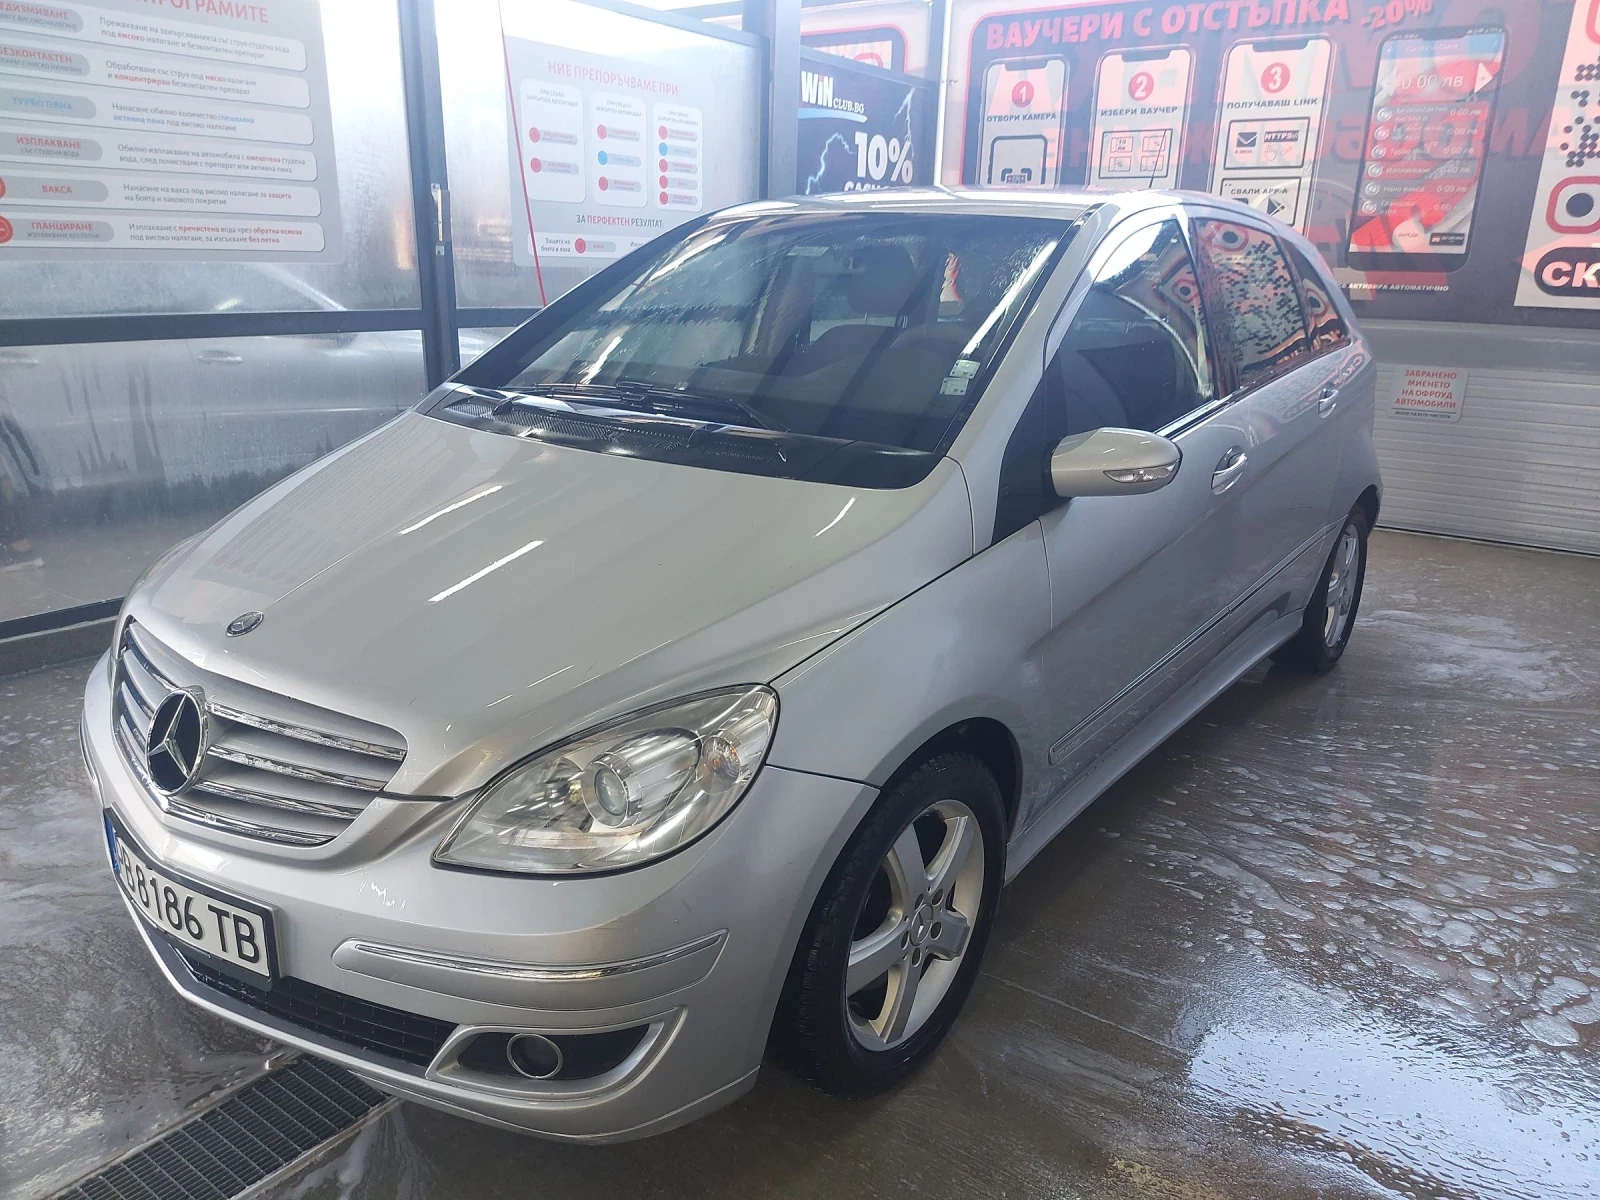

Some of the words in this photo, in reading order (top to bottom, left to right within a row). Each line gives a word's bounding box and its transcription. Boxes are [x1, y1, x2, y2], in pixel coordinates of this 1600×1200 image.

[100, 16, 149, 32] Премахване
[987, 12, 1124, 50] ВАУЧЕРИ
[1133, 8, 1153, 37] С
[1162, 0, 1348, 34] ОТСТЪПКА
[102, 30, 116, 39] под
[118, 32, 145, 42] високо
[106, 60, 157, 74] Обработване
[191, 73, 205, 81] под
[205, 75, 226, 83] ниско
[548, 61, 573, 78] НИЕ
[574, 66, 658, 94] ПРЕПОРЪЧВАМЕ
[114, 74, 171, 86] концентриран
[1269, 66, 1283, 91] 3
[1401, 73, 1437, 90] 0.00
[1134, 75, 1149, 98] 2
[1019, 85, 1027, 102] 1
[112, 103, 150, 114] Нанасяне
[1227, 99, 1291, 110] ПОЛУЧАВАШ
[1294, 98, 1319, 107] LINK
[986, 114, 1020, 123] ОТВОРИ
[1022, 112, 1057, 121] КАМЕРА
[1100, 107, 1137, 117] ИЗБЕРИ
[1140, 106, 1178, 115] ВАУЧЕР
[166, 119, 180, 127] под
[16, 136, 82, 149] ИЗПЛАКВАНЕ
[117, 144, 148, 154] Обилно
[149, 148, 190, 157] изплакване
[158, 159, 199, 167] почистване
[855, 131, 913, 184] 10%
[42, 185, 73, 195] ВАКСА
[124, 183, 159, 192] Нанасяне
[191, 188, 205, 196] под
[1230, 188, 1260, 198] СВАЛИ
[135, 193, 156, 203] боята
[576, 214, 586, 224] ЗА
[587, 215, 630, 227] ПЕРФЕКТЕН
[31, 222, 93, 232] ГЛАНЦИРАНЕ
[129, 223, 174, 232] Изплакване
[249, 235, 260, 243] без
[1348, 282, 1388, 290] АКТИВИРА
[1389, 284, 1450, 292] АВТОМАТИЧНО
[1404, 369, 1457, 380] ЗАБРАНЕНО
[1407, 379, 1451, 389] МИЕНЕТО
[1401, 388, 1414, 397] НА
[1415, 389, 1453, 400] ОФРОУД
[1394, 398, 1456, 409] АВТОМОБИЛИ
[136, 864, 204, 941] 8186
[208, 904, 261, 964] TB
